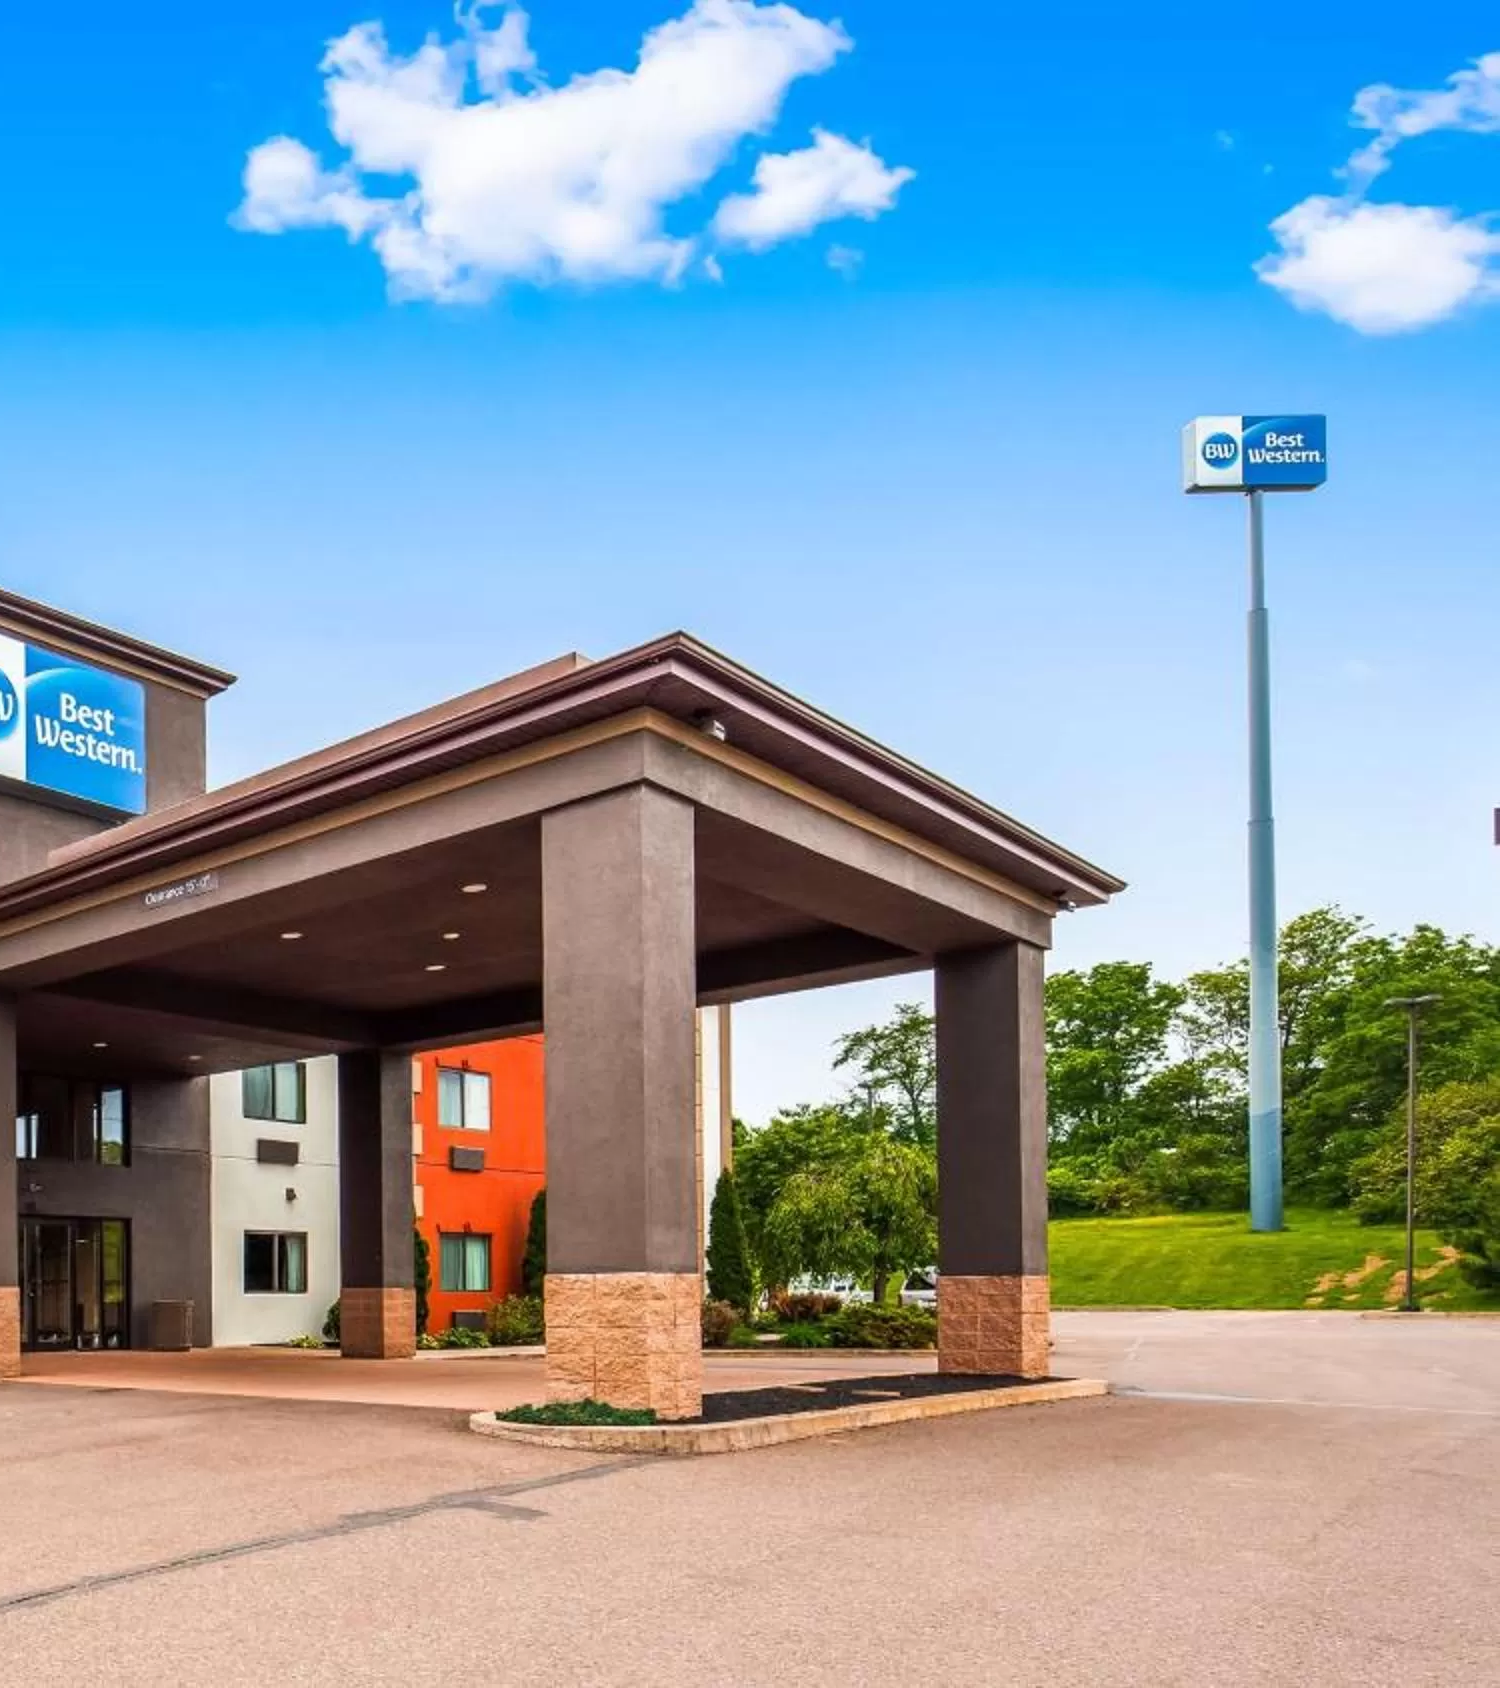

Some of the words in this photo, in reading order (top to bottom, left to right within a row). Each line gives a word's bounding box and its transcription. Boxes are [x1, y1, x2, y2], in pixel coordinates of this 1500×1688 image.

[1265, 432, 1305, 447] Best
[1205, 443, 1235, 459] BW
[59, 692, 115, 737] Best
